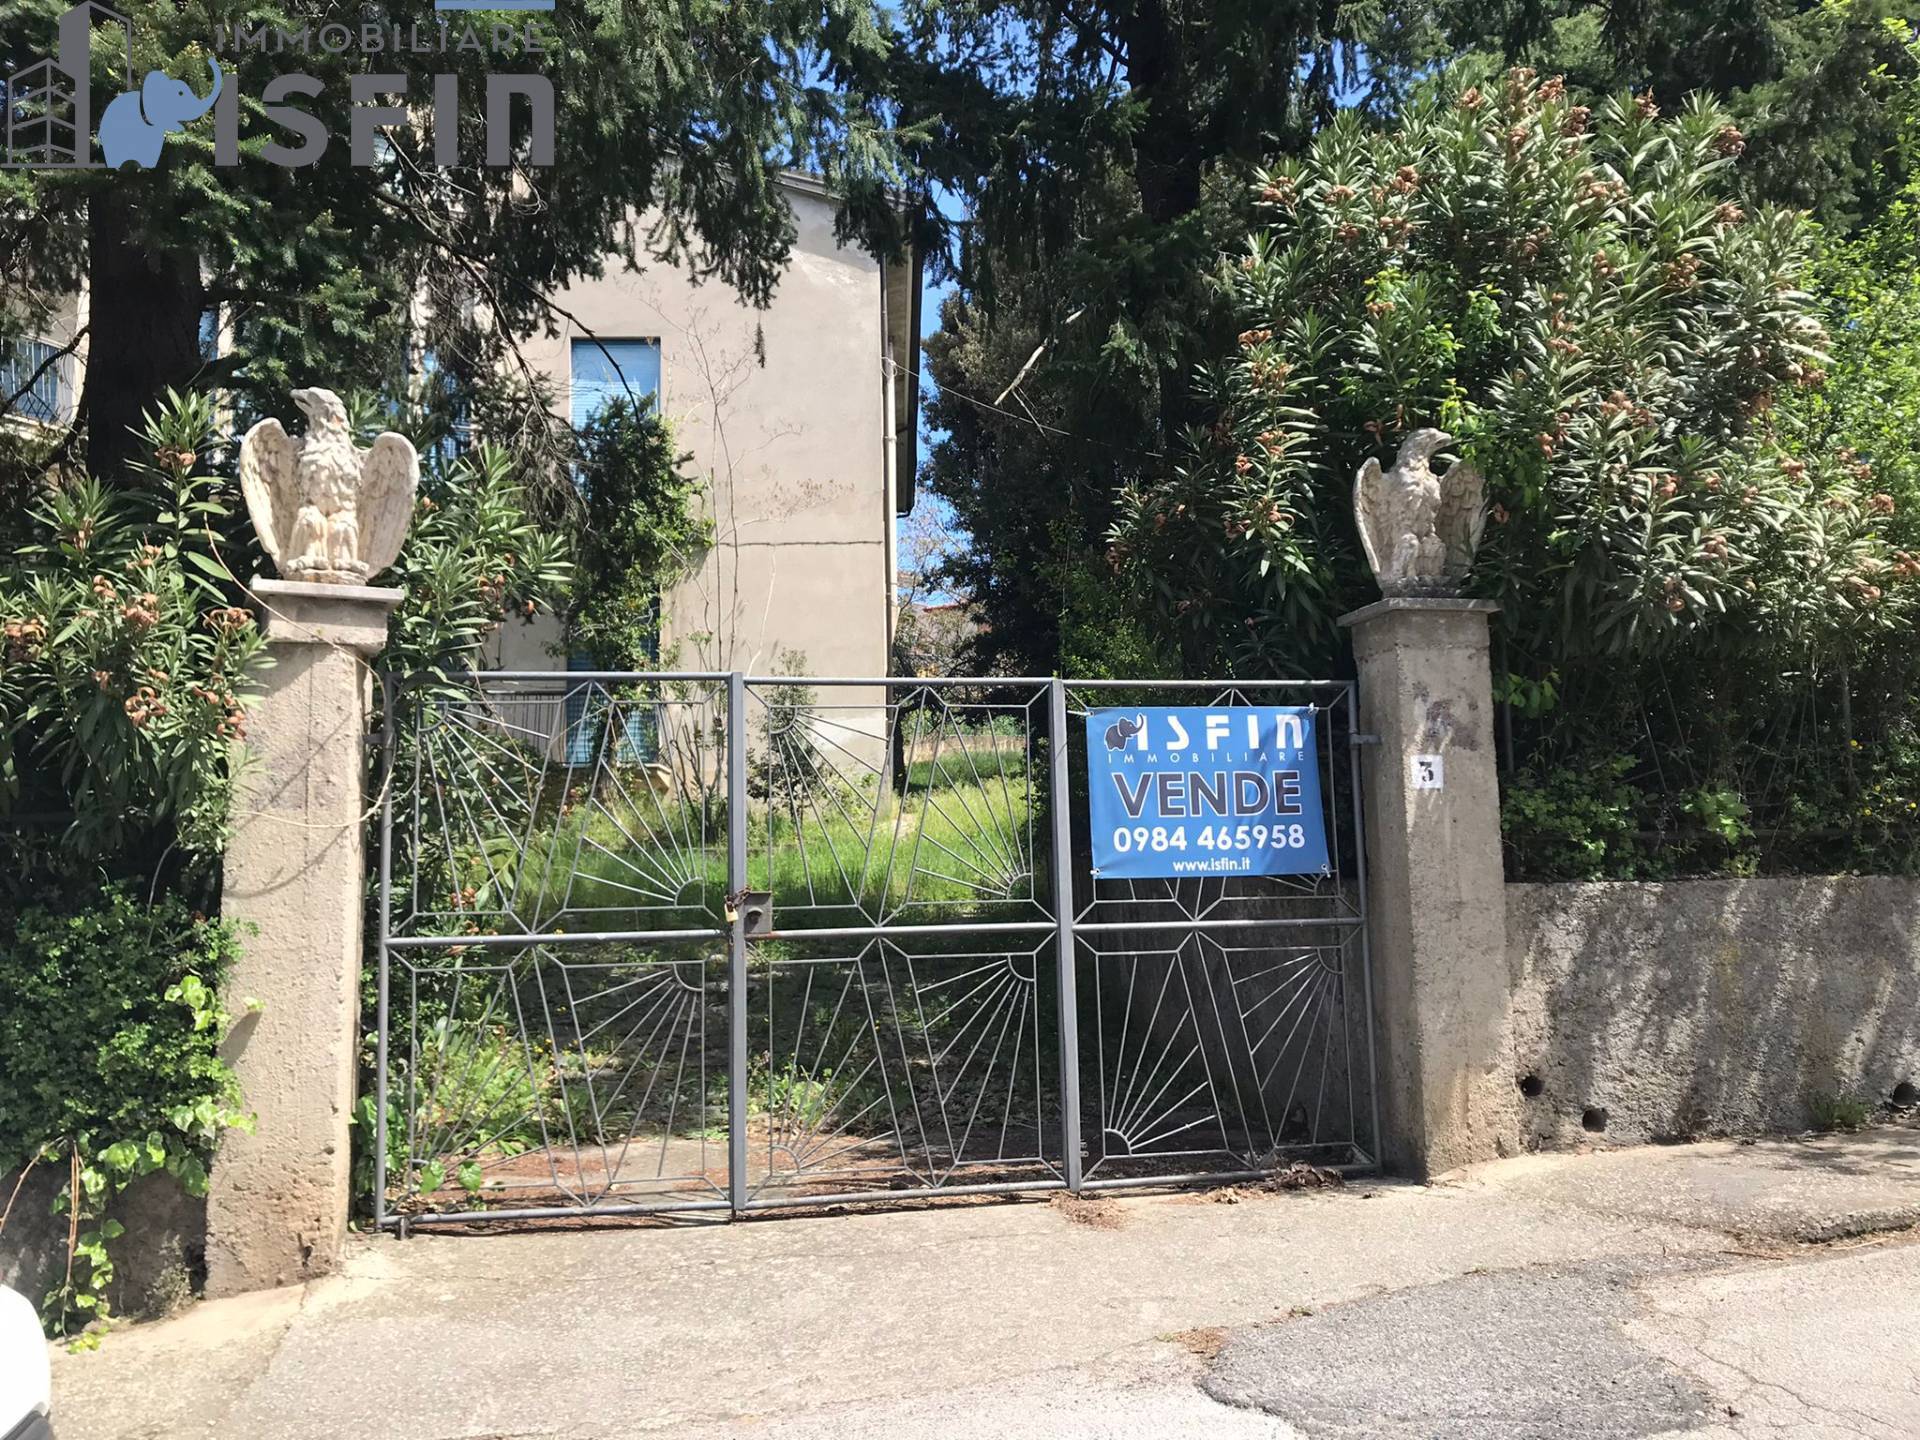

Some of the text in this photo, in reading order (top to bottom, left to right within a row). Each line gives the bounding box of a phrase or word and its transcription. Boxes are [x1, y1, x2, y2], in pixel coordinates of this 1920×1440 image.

[1108, 751, 1304, 764] IMMOBILIARE
[1419, 761, 1434, 782] 3
[1111, 770, 1302, 818] VENDE
[1113, 824, 1306, 852] 0984 465958
[1173, 857, 1251, 872] www.isfin.it
